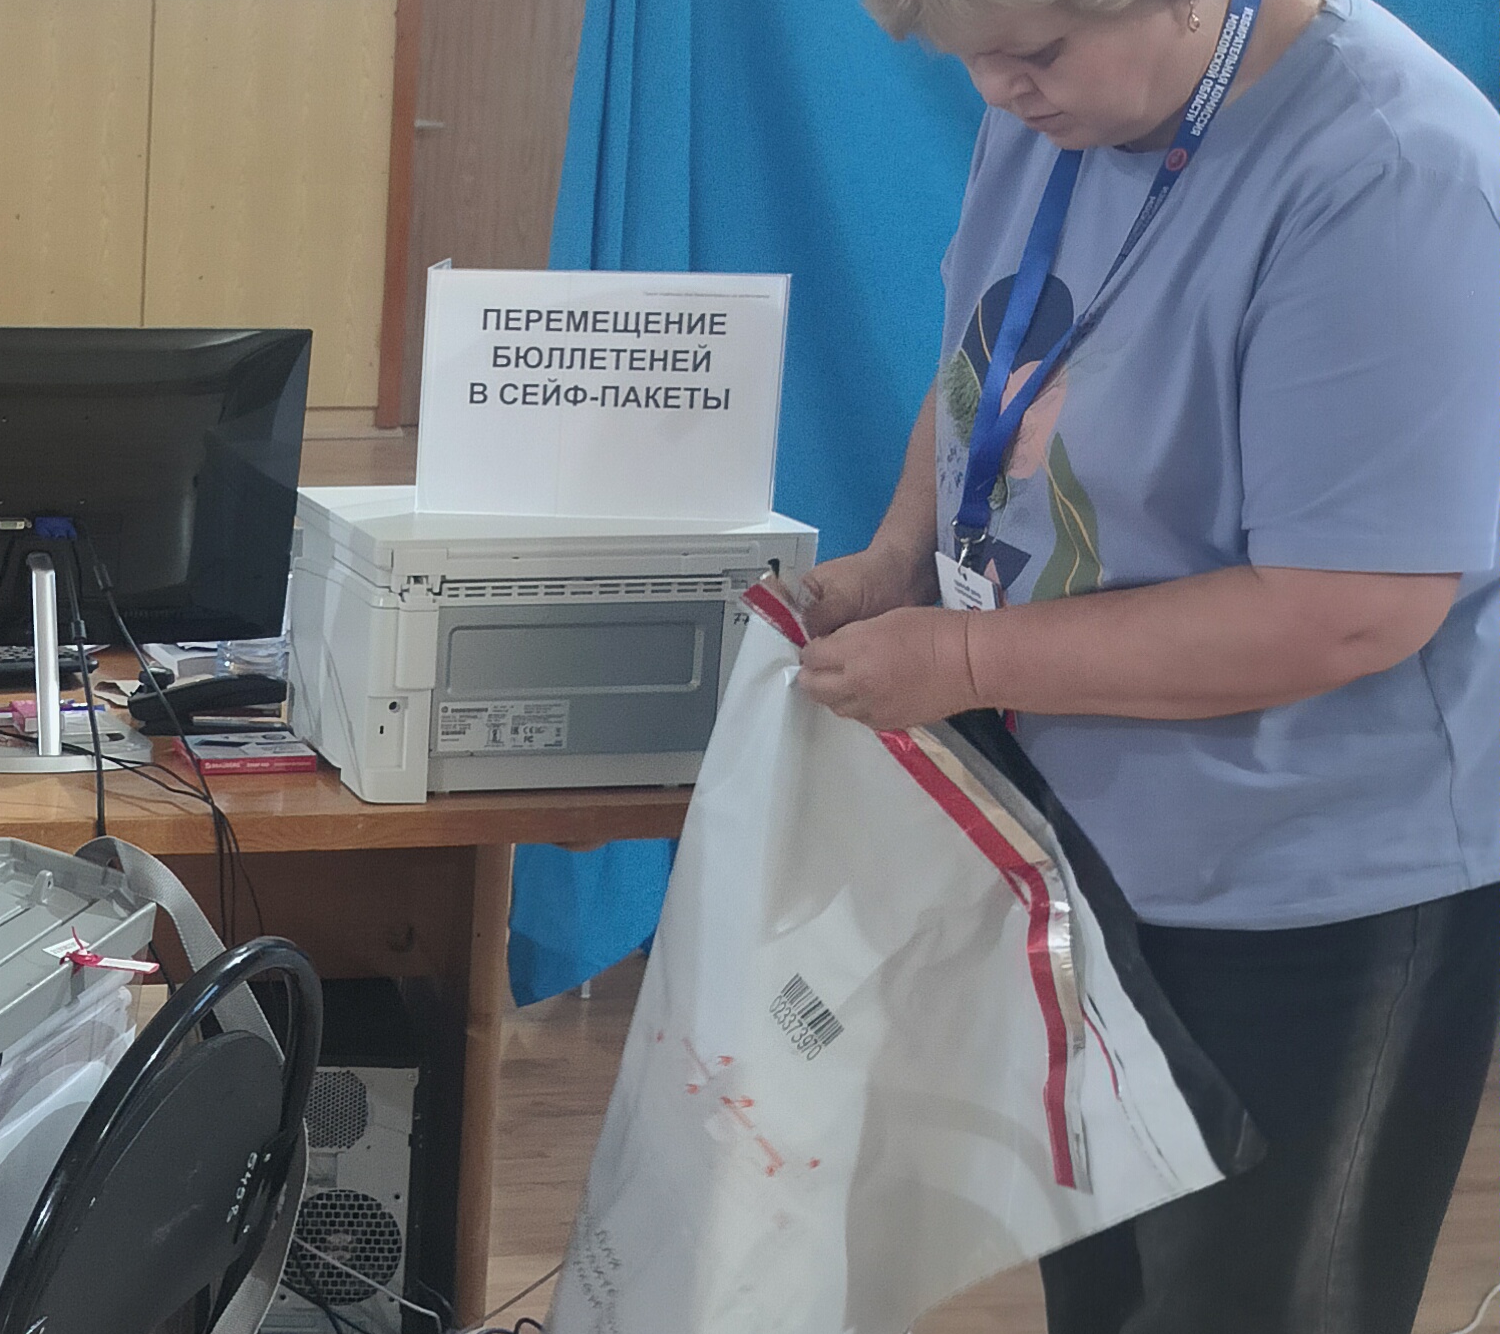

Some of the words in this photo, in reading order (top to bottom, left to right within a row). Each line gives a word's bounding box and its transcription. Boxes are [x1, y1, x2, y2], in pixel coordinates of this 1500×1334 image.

[1206, 13, 1240, 79] МОСКОВСКОЙ
[1218, 6, 1254, 84] ИЗБИРАТЕЛЬНАЯ
[1185, 79, 1214, 122] ОБЛАСТИ
[1190, 83, 1226, 137] КОМИССИЯ
[481, 308, 728, 339] ПЕРЕМЕЩЕНИЕ
[492, 344, 712, 373] БЮЛЛЕТЕНЕЙ
[468, 382, 488, 405] В
[499, 378, 731, 410] СЕЙФ-ПАКЕТЫ
